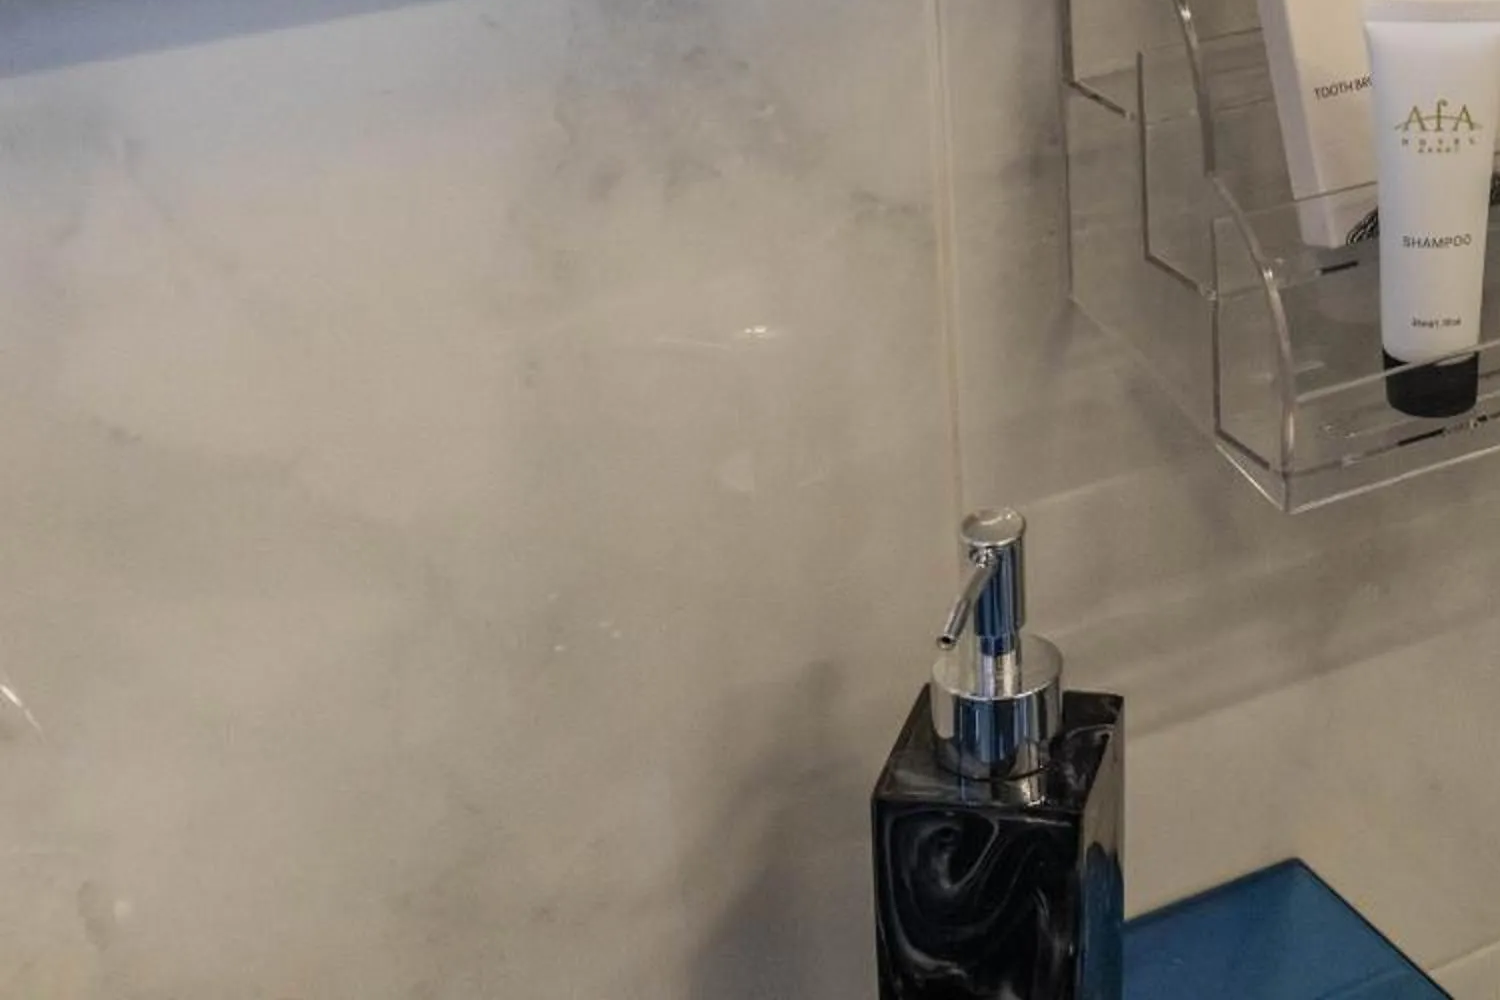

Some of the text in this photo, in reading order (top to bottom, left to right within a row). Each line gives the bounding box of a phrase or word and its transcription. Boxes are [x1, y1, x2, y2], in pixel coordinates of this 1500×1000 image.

[1313, 80, 1354, 101] TOOTH
[1400, 99, 1477, 132] AfA
[1401, 233, 1472, 249] SHAMPOO
